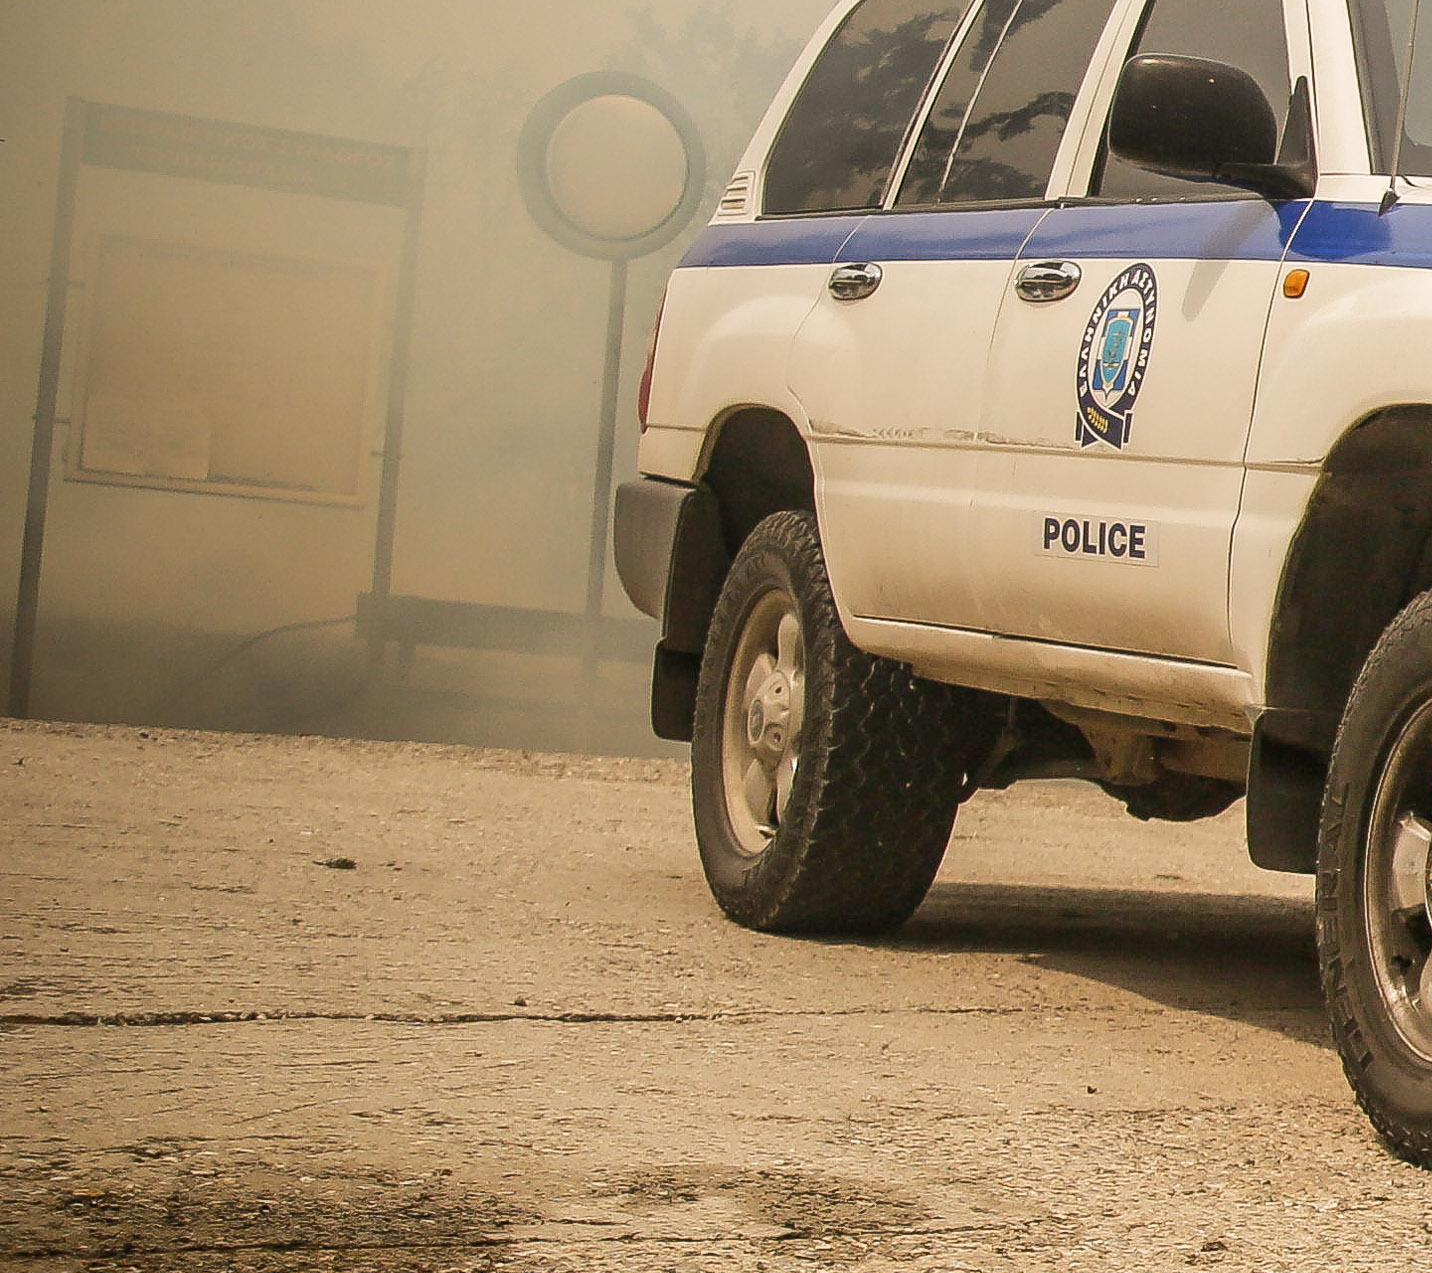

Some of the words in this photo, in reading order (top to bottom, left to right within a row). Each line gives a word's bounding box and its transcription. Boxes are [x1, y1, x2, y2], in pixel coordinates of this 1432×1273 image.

[1079, 272, 1130, 398] ΕΛΛΗΝΙΚΗ
[1127, 269, 1155, 396] ΑΣΤΥΝΟΜΙΑ
[1043, 517, 1146, 559] POLICE
